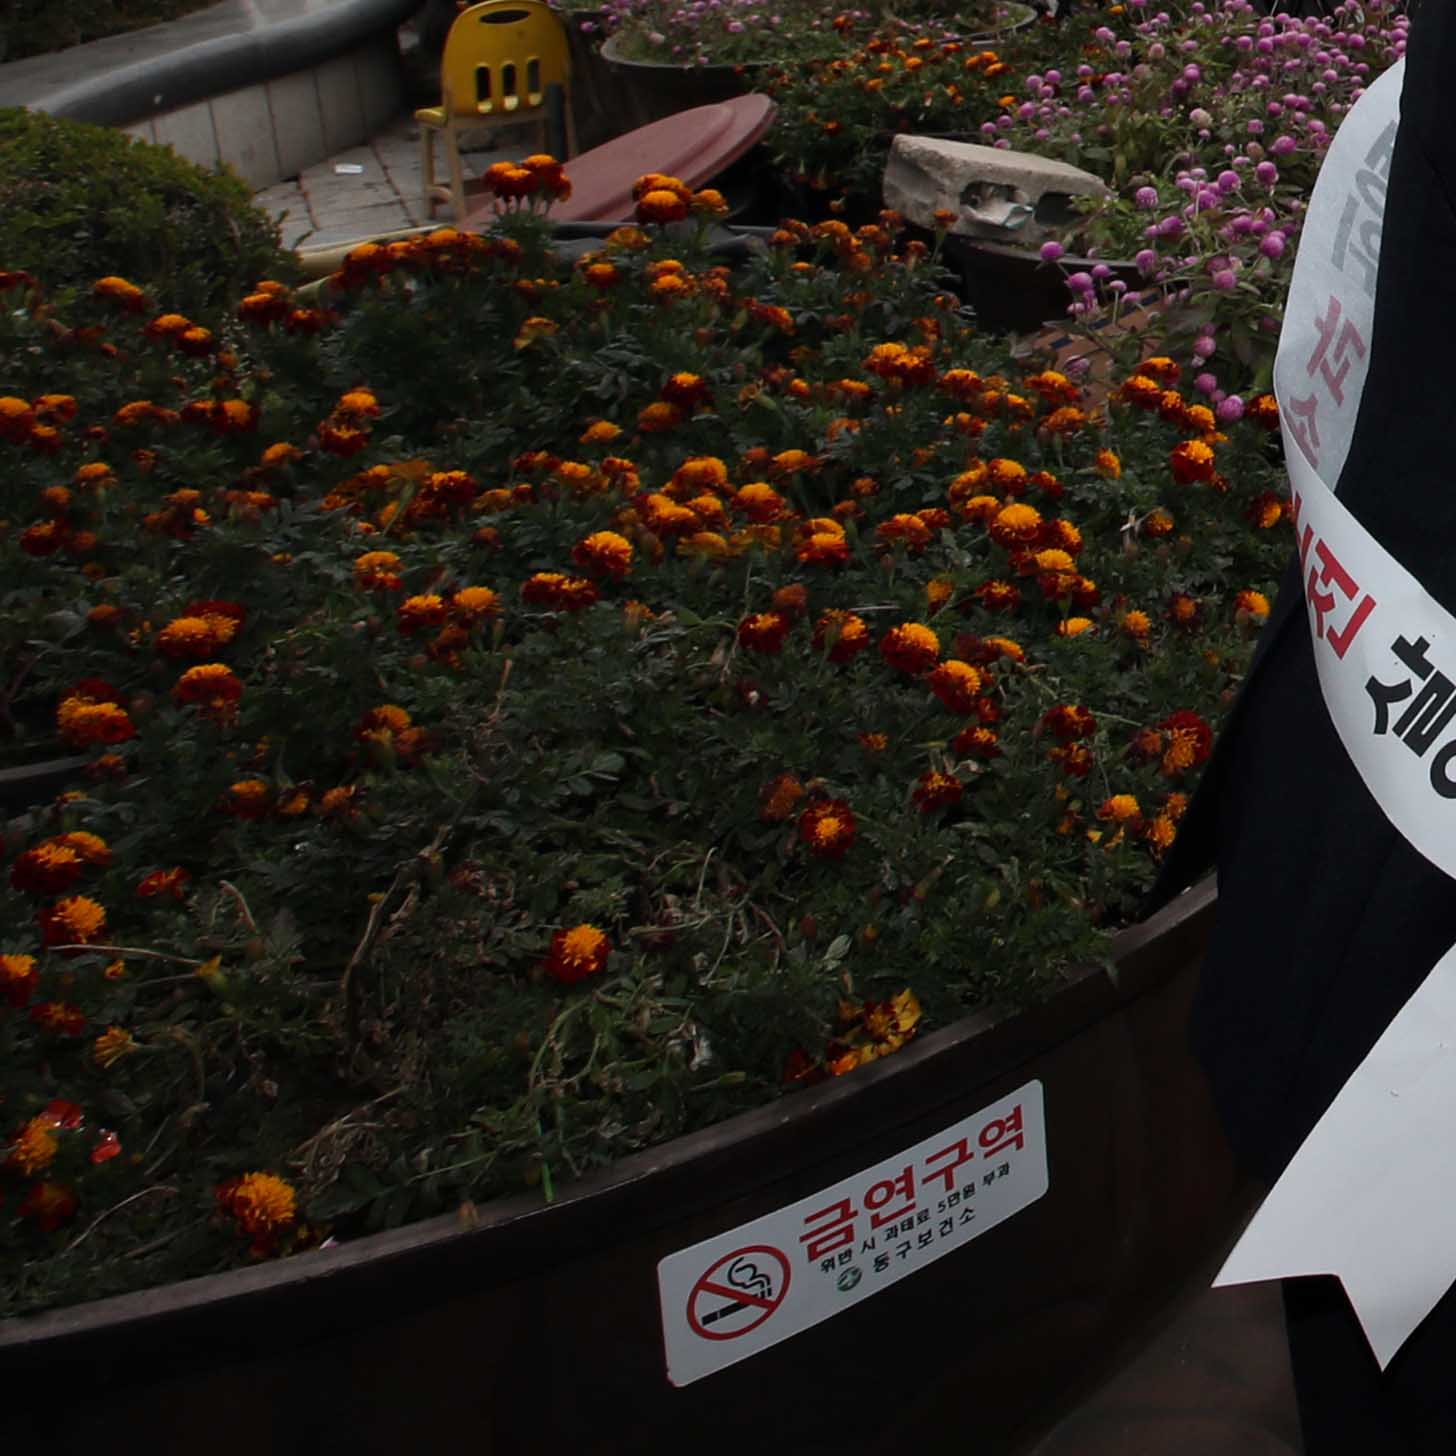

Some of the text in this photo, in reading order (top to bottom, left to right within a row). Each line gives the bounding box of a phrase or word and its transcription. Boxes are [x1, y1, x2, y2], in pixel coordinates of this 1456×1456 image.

[799, 1103, 1025, 1263] 금연구역
[820, 1161, 1010, 1274] 위반 시 과태료 5만원 부과
[873, 1206, 977, 1274] 동구보건소
